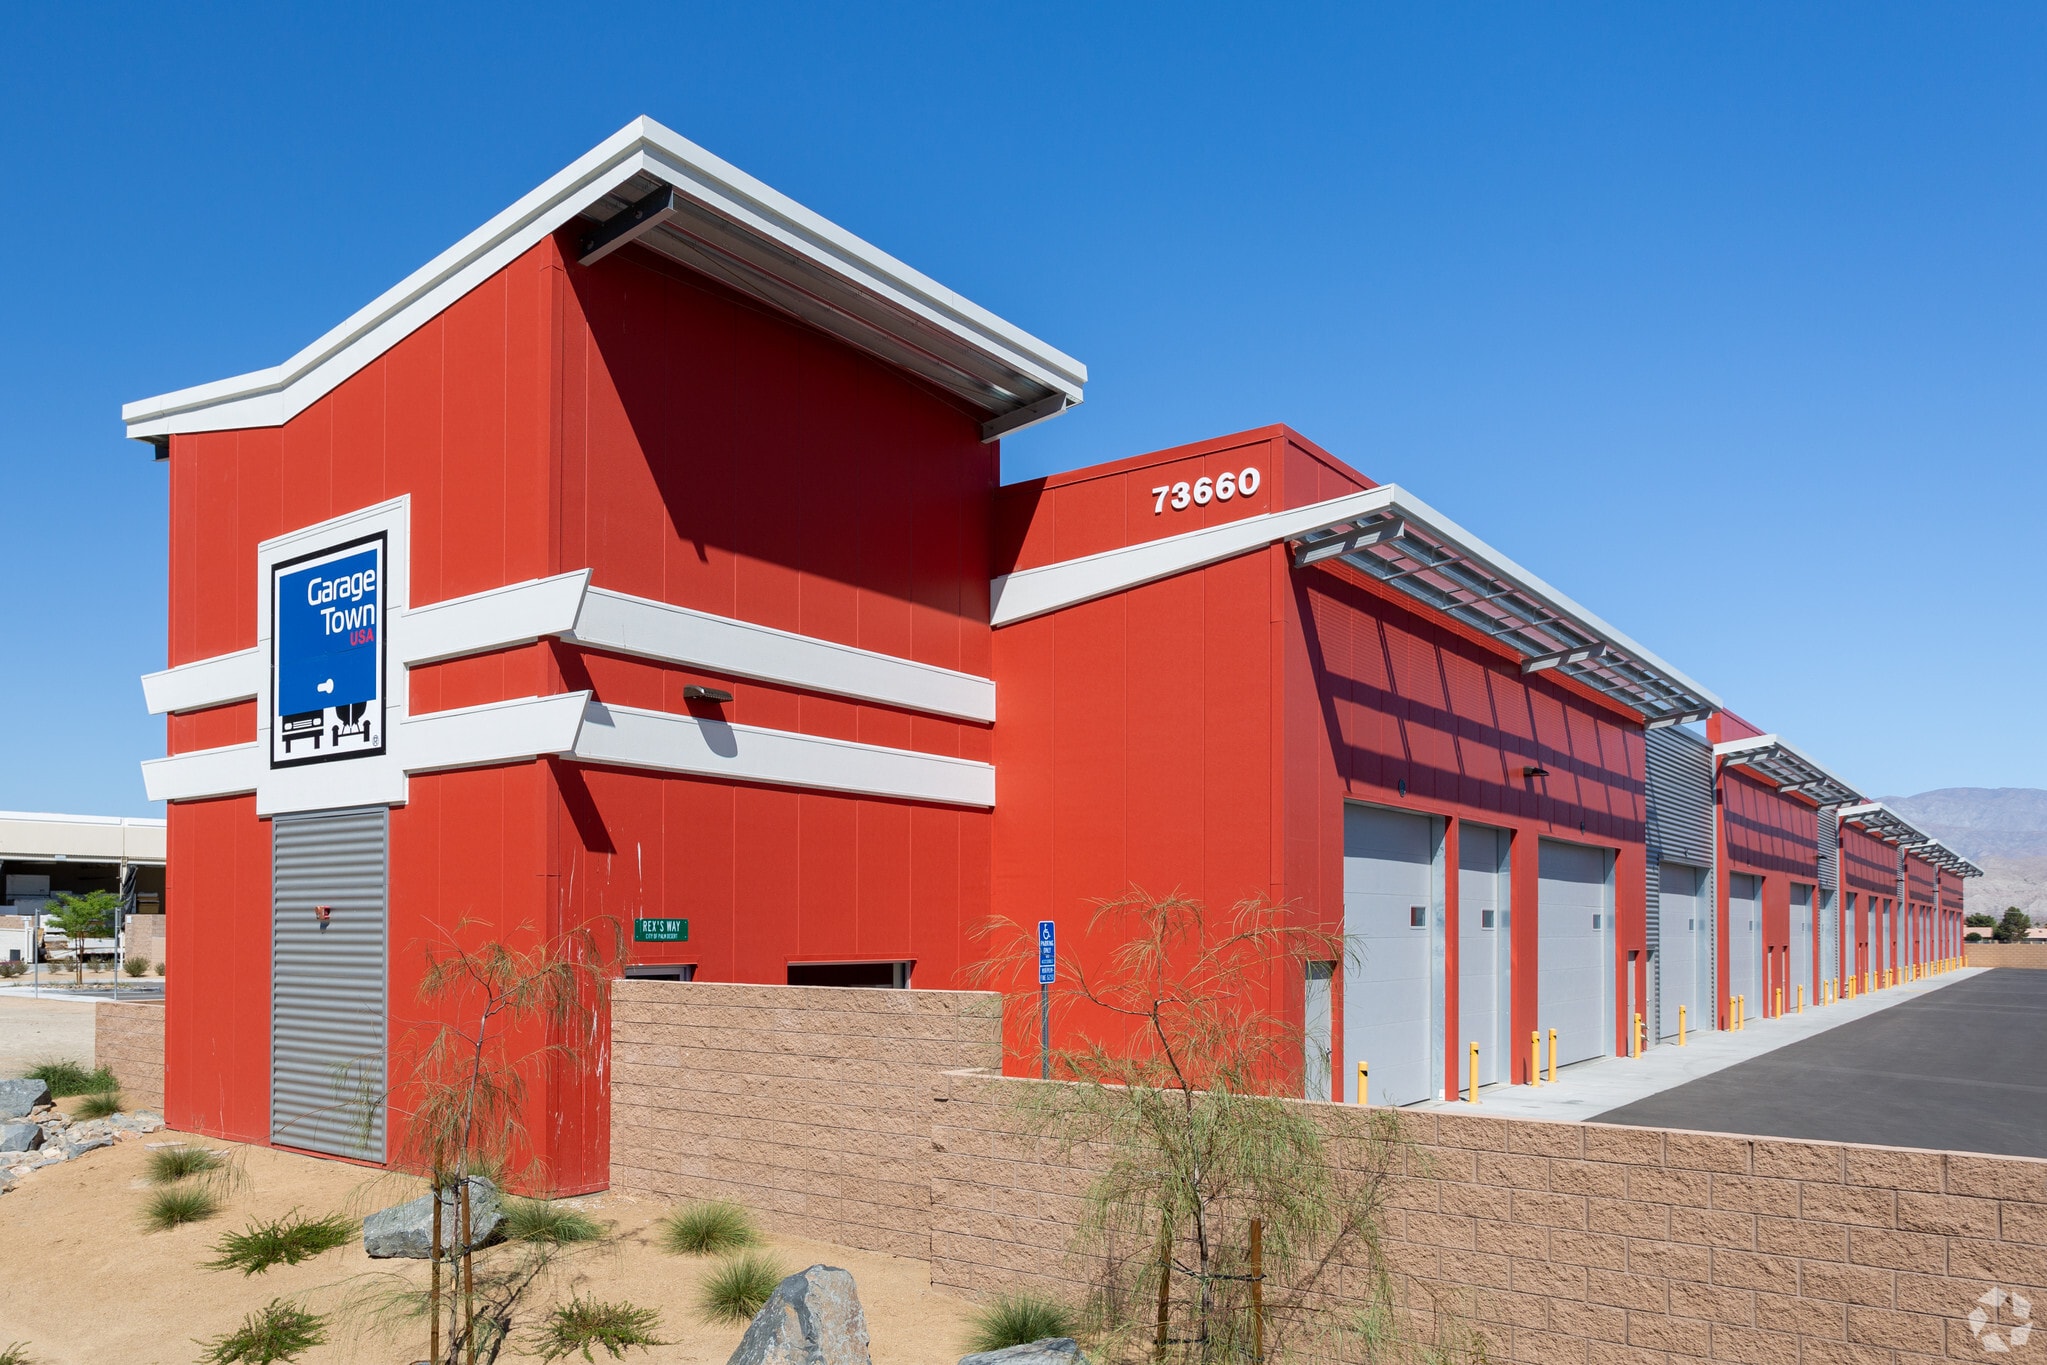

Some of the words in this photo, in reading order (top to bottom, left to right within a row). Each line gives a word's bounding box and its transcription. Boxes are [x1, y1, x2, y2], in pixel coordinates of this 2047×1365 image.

[1151, 467, 1261, 514] 73660
[307, 569, 376, 606] Garage
[320, 603, 375, 636] Town
[349, 628, 375, 646] USA
[642, 920, 665, 932] REX'S
[666, 920, 681, 932] WAY
